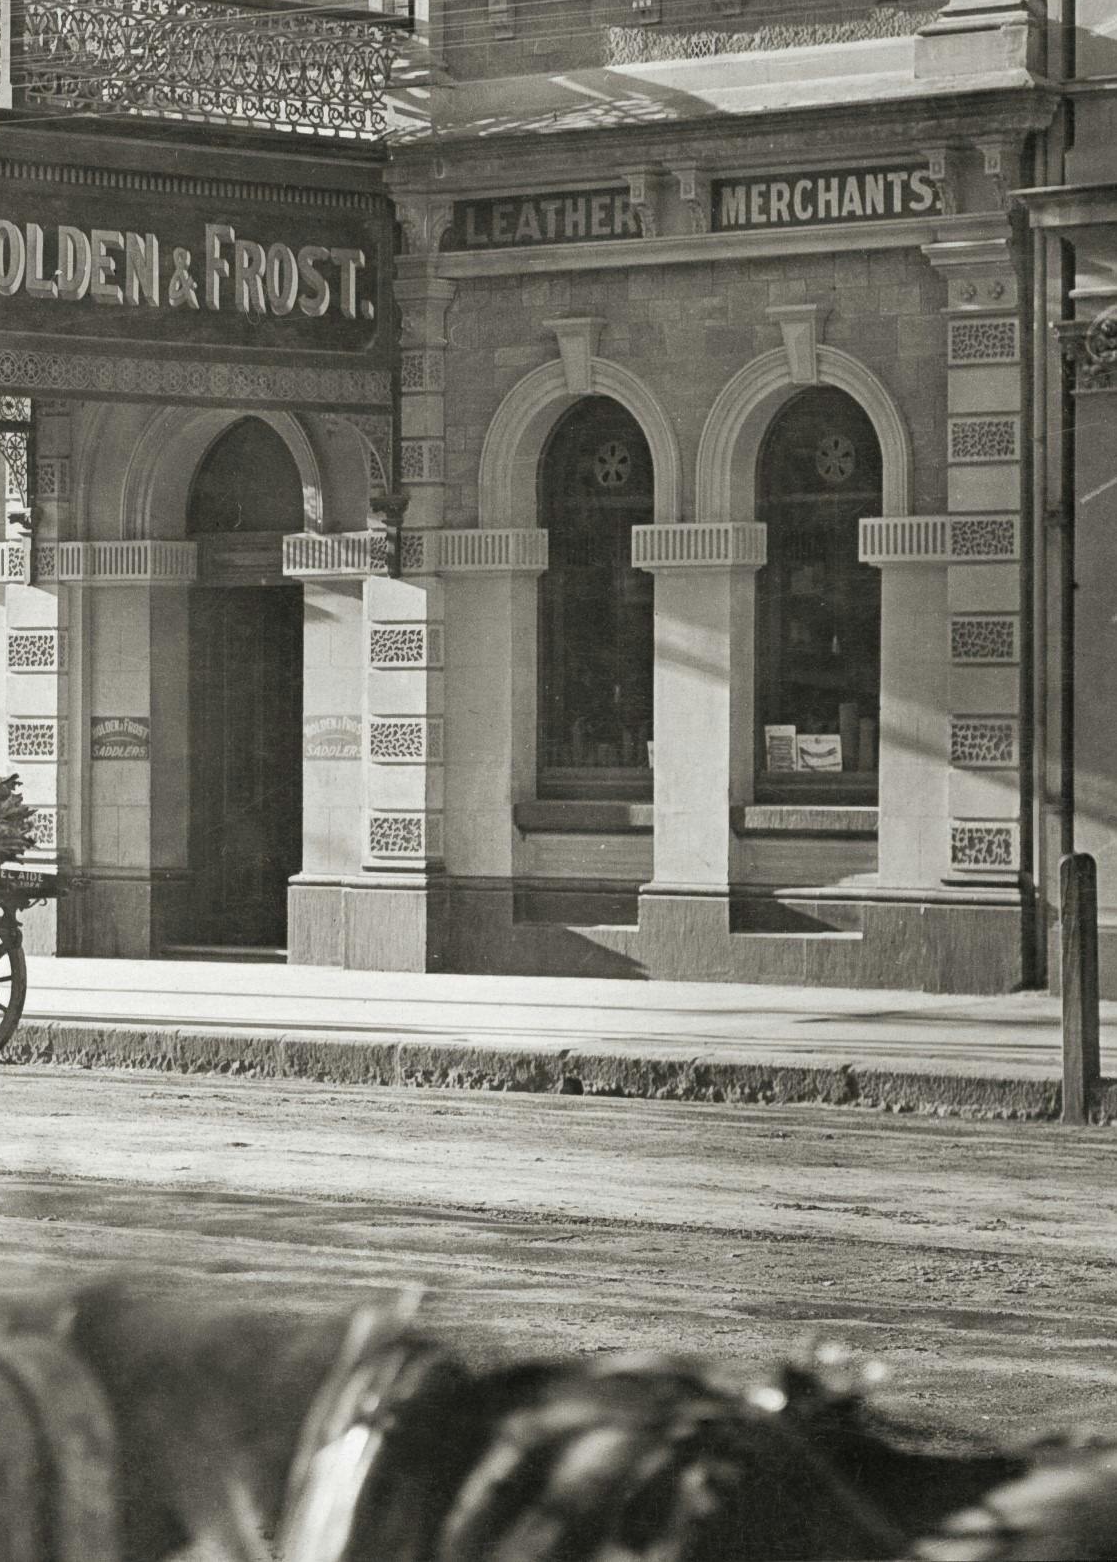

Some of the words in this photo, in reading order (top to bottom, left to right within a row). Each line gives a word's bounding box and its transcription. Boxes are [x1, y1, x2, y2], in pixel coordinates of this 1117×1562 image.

[465, 194, 640, 246] LEATHER
[169, 247, 200, 310] &
[205, 223, 375, 320] FROST.
[123, 717, 150, 740] FROST
